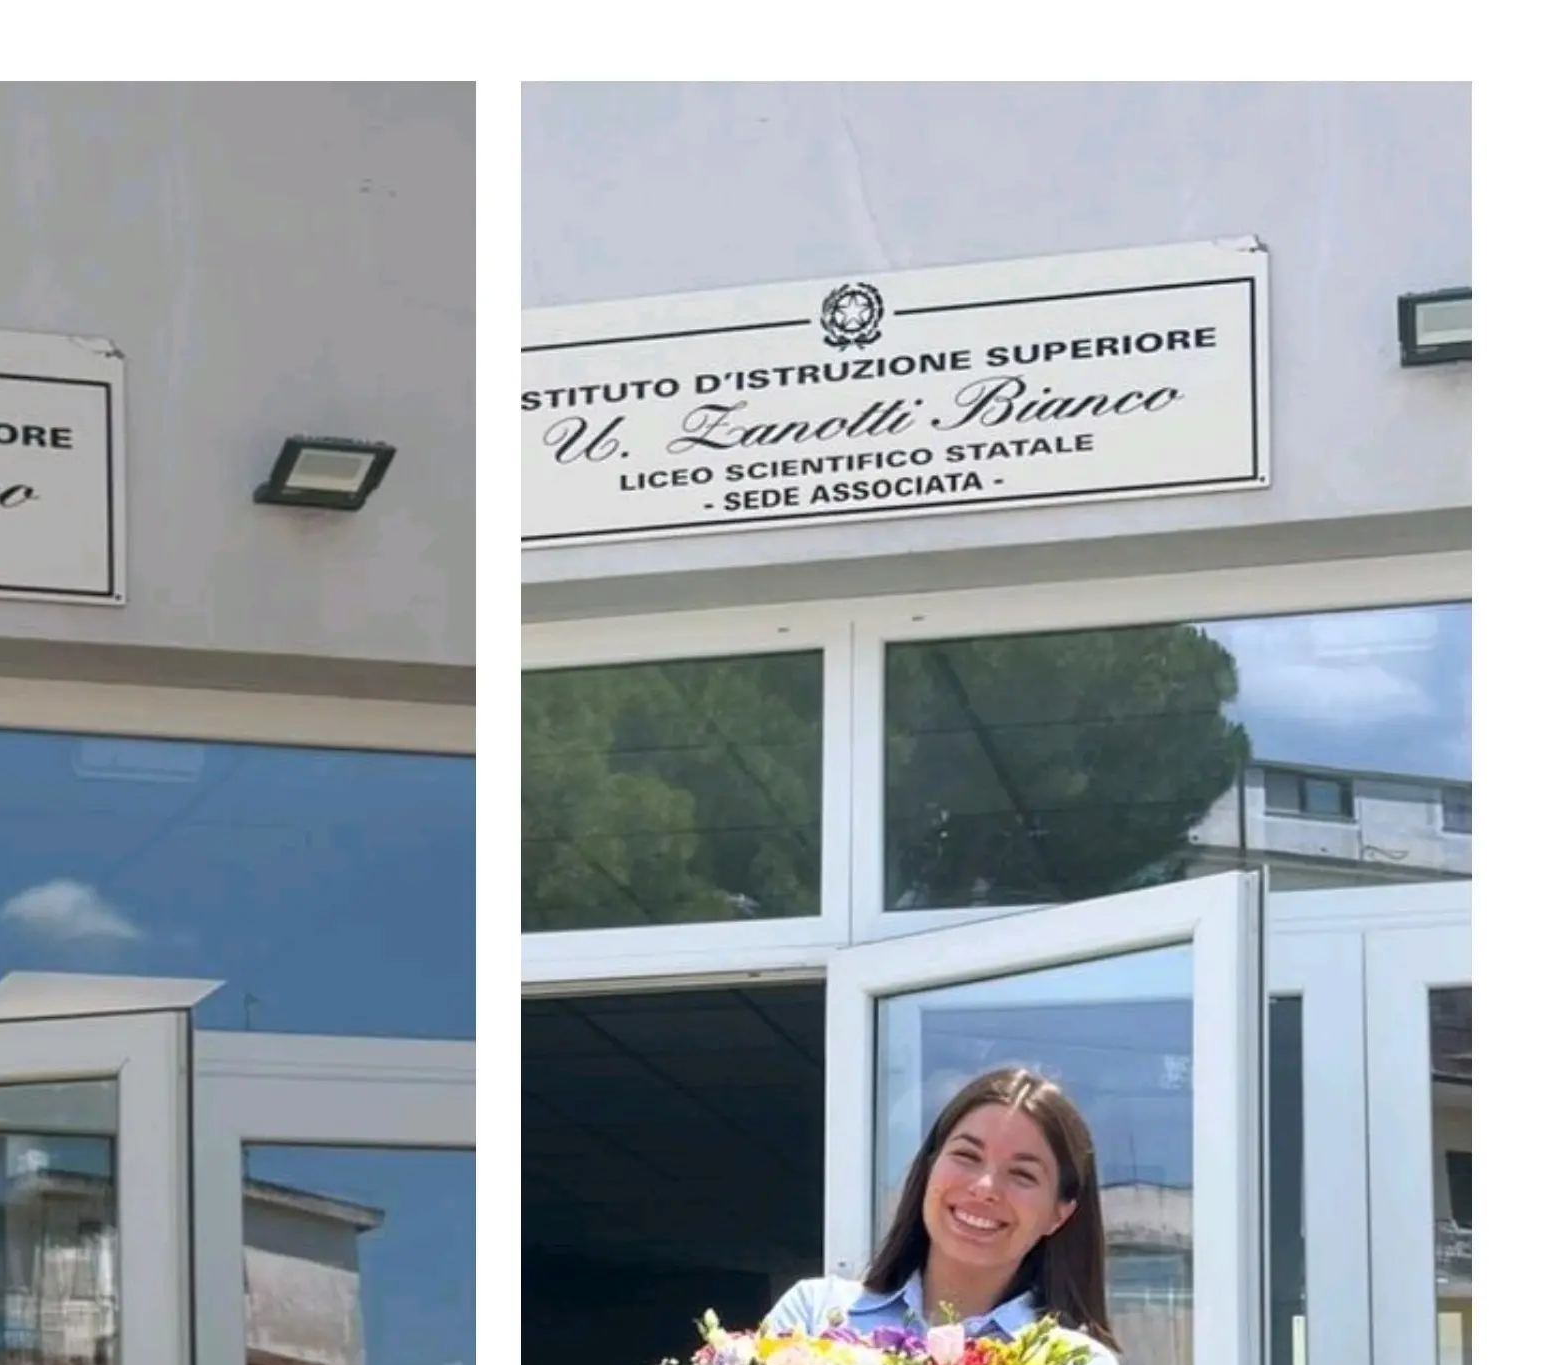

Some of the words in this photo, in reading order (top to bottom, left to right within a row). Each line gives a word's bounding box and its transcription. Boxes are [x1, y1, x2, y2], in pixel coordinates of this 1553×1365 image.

[696, 351, 971, 394] D'ISTRUZIONE
[987, 328, 1216, 367] SUPERIORE
[541, 415, 630, 467] U.
[666, 398, 925, 452] Zanotti
[932, 375, 1185, 429] Bianco
[621, 468, 713, 491] LICEO
[727, 449, 933, 481] SCIENTIFICO
[947, 434, 1093, 462] STATALE
[725, 487, 799, 511] SEDE
[811, 472, 983, 504] ASSOCIATA
